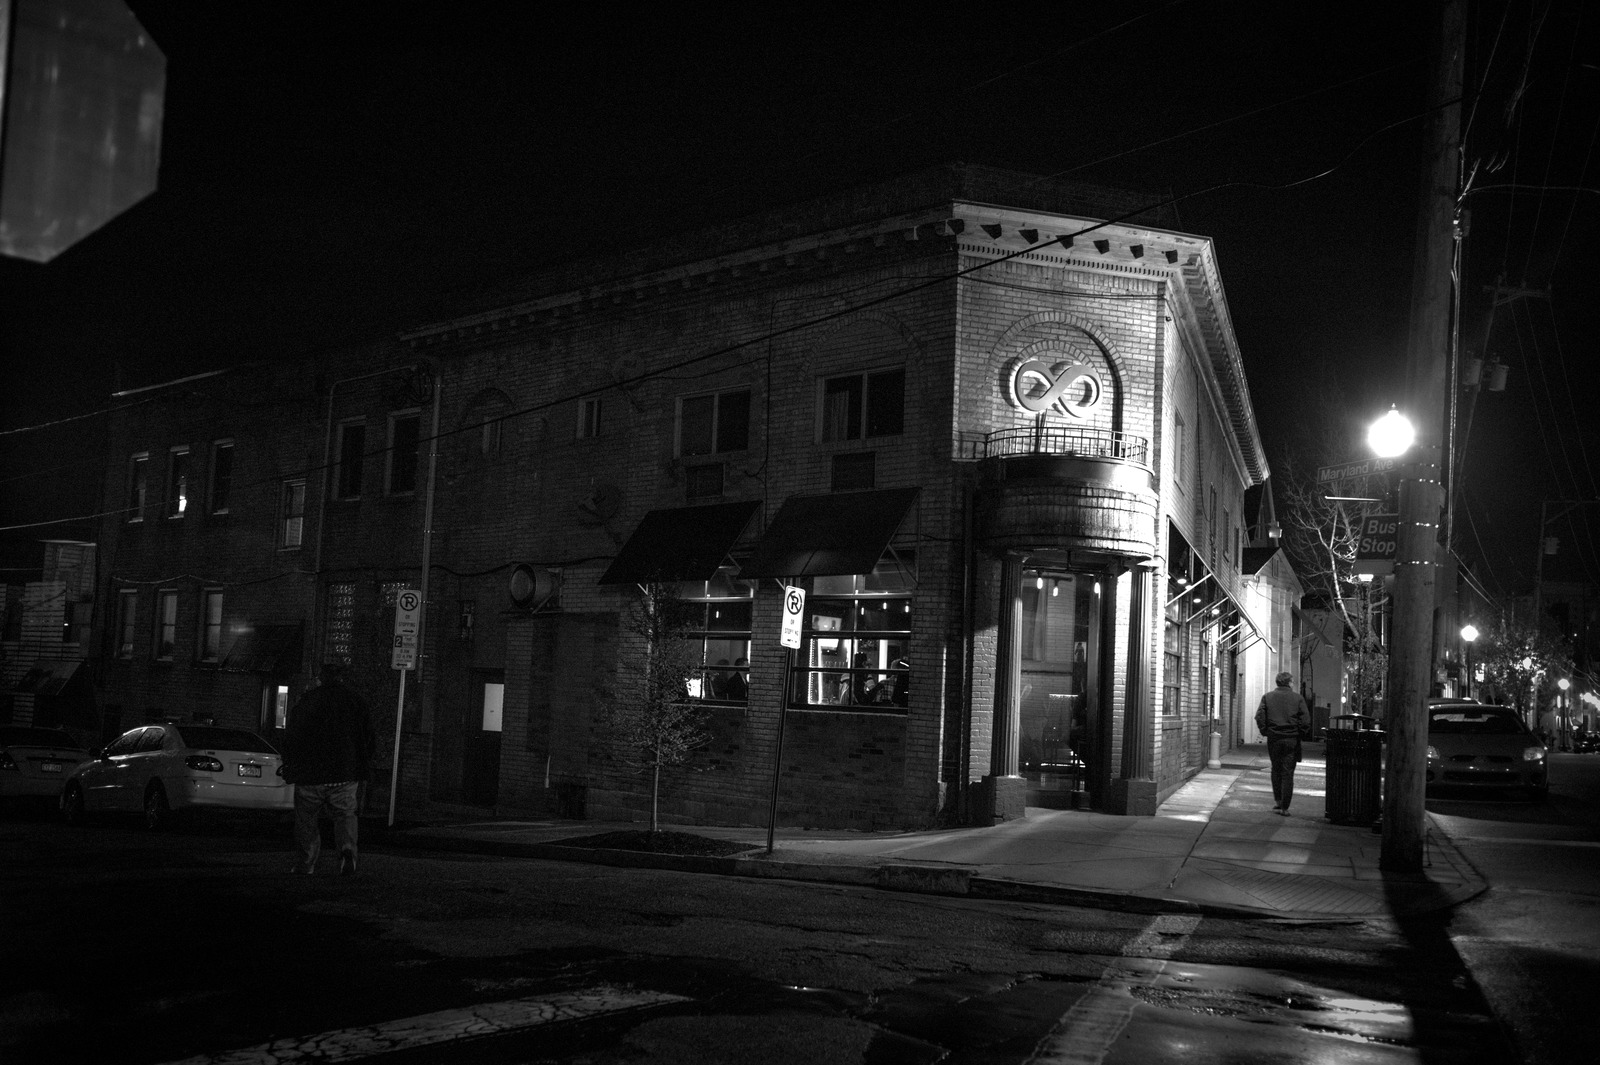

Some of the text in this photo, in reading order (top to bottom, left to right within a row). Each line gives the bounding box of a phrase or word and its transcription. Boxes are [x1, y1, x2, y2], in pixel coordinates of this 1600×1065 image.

[1321, 459, 1393, 480] Maryland Ave
[1367, 520, 1397, 534] Bus
[1360, 538, 1396, 555] Stop
[396, 637, 402, 647] 2
